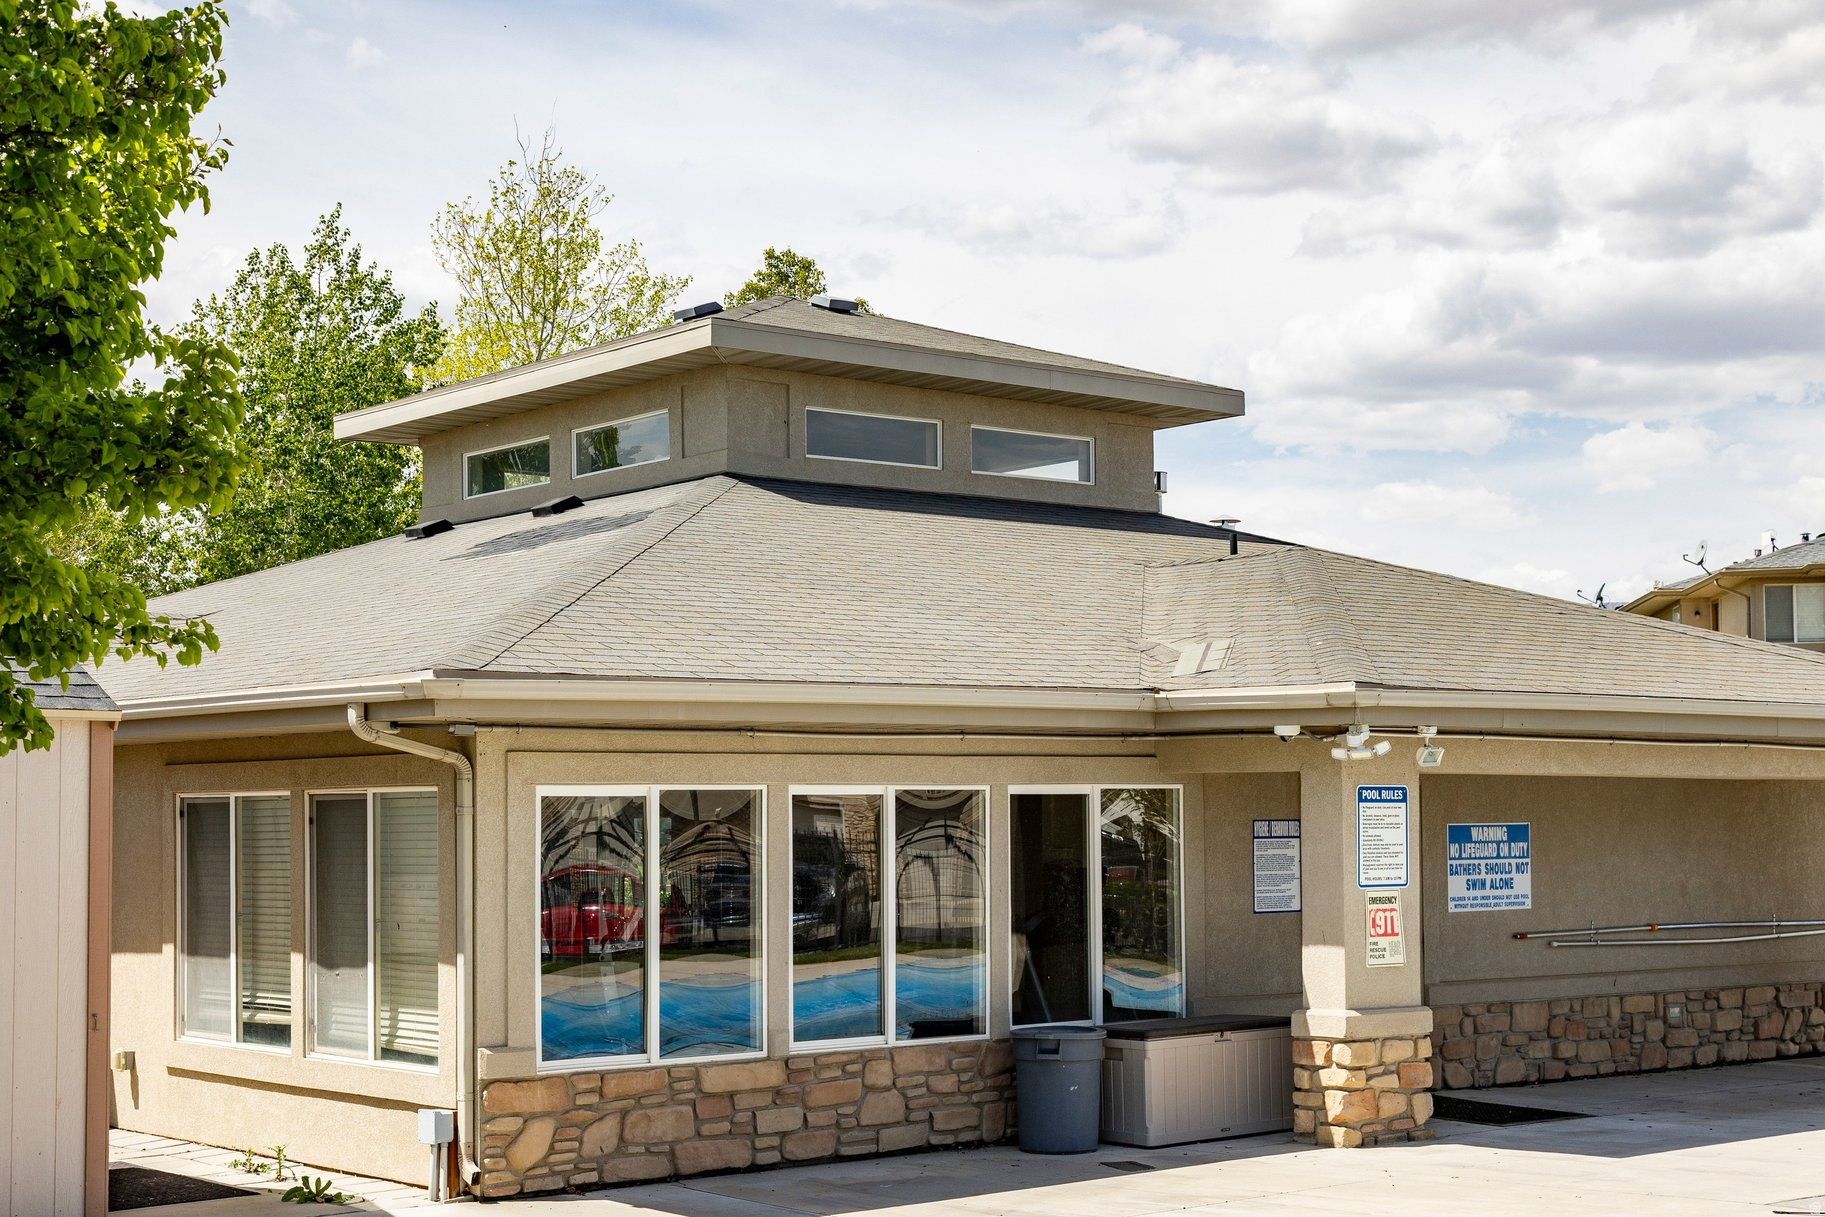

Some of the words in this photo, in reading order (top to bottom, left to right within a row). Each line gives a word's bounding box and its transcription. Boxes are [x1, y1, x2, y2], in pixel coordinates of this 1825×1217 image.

[1362, 790, 1380, 800] POOL
[1382, 790, 1403, 800] RULES
[1471, 827, 1507, 841] WARNING
[1450, 843, 1459, 858] NO
[1462, 842, 1497, 858] LIFEGUARD
[1500, 842, 1508, 857] ON
[1511, 842, 1527, 856] DUTY
[1450, 863, 1481, 876] BATHERS
[1485, 862, 1512, 875] SHOULD
[1516, 862, 1529, 874] NOT
[1466, 878, 1486, 891] SWIM
[1490, 877, 1514, 890] ALONE
[1369, 896, 1397, 905] EMERGENCY
[1376, 910, 1399, 934] 911
